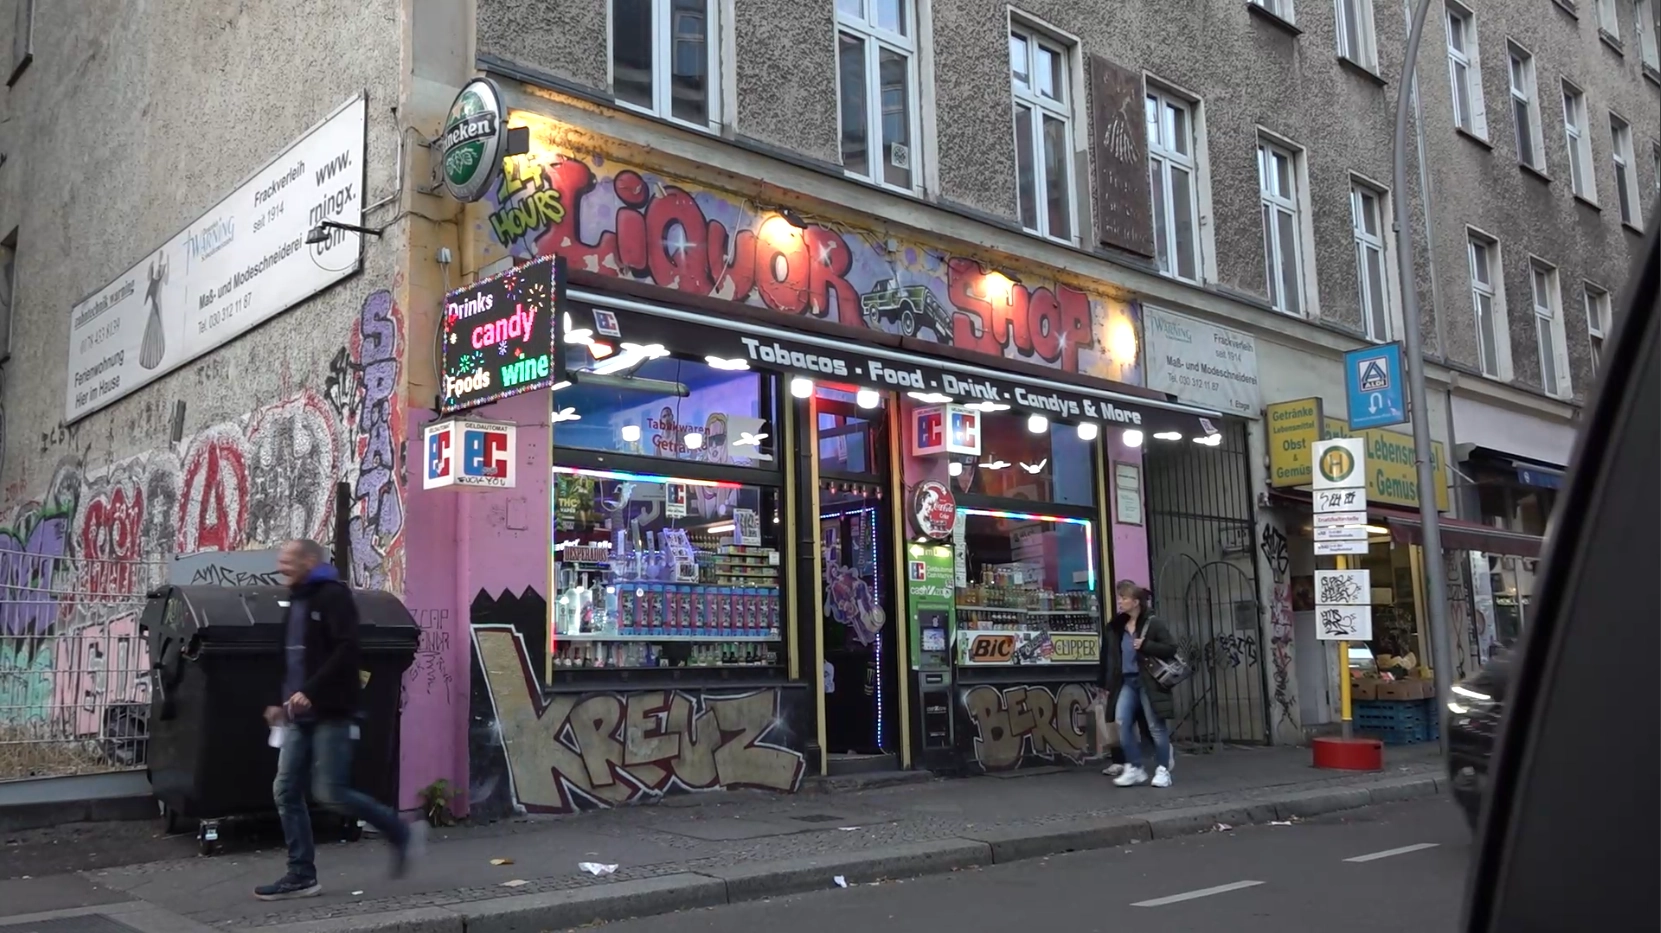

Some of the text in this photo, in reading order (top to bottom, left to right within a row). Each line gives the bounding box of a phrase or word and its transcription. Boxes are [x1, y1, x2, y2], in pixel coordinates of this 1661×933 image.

[253, 160, 305, 209] Frackverleih
[315, 149, 352, 188] www.
[498, 153, 544, 203] 24
[253, 201, 285, 234] seit 1914
[489, 189, 566, 249] HOURS
[199, 289, 217, 310] Maß-
[218, 277, 232, 299] und
[233, 232, 303, 290] Modeschneiderei
[221, 302, 234, 322] 312
[447, 291, 494, 323] Drinks
[947, 256, 1094, 374] SHOP
[471, 303, 538, 350] candy
[1213, 333, 1254, 352] Frackverleih
[74, 349, 124, 388] Ferienwohnung
[501, 353, 549, 388] wine
[1166, 355, 1258, 386] Maß- und Modeschneiderei
[1227, 351, 1242, 362] 1914
[75, 391, 89, 410] Hier
[98, 375, 120, 397] Hause
[446, 367, 491, 399] Foods
[741, 336, 1142, 426] Tobacos Food Drink Candys & More
[1179, 375, 1191, 386] 030
[1191, 377, 1203, 389] 312
[1363, 380, 1386, 390] ALDI
[1235, 400, 1250, 412] Etage
[1272, 406, 1314, 422] Getränke
[464, 422, 508, 432] GELDAUTOMAT
[646, 418, 711, 436] Tabakwaren
[1273, 420, 1315, 435] Lebensmittel
[1283, 438, 1306, 451] Obst
[1276, 463, 1312, 479] Gemüs
[1376, 468, 1420, 501] Gemüs
[558, 498, 578, 507] THC
[1054, 639, 1097, 657] CLIPPER
[470, 623, 806, 814] KREUZ
[964, 682, 1104, 770] BERG
